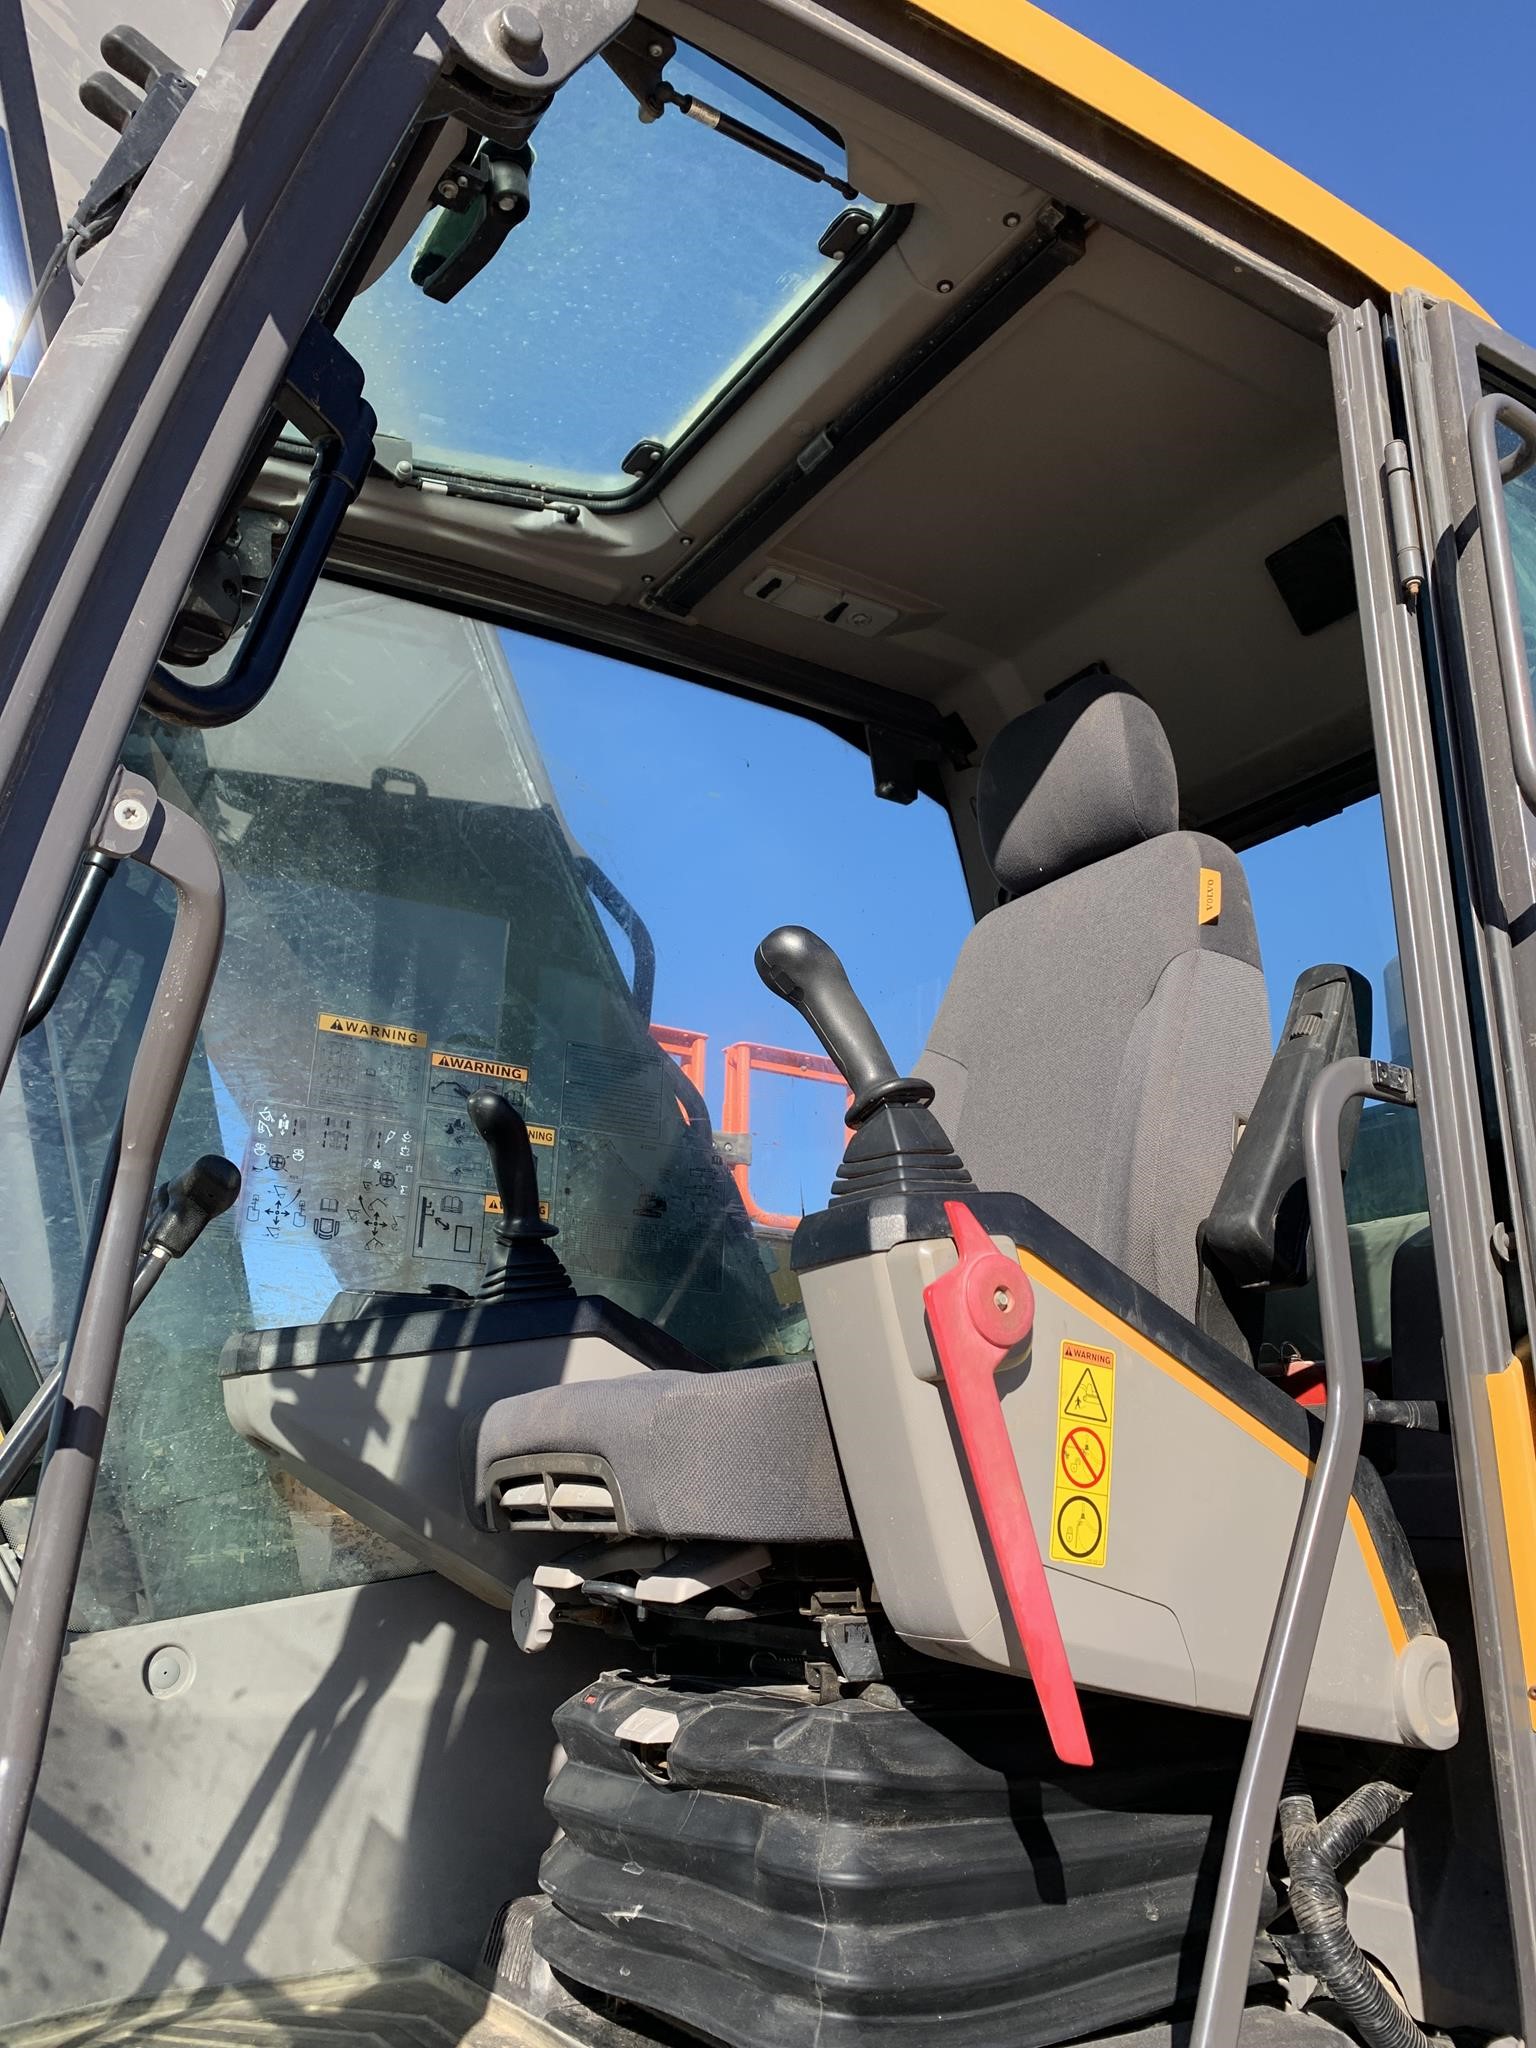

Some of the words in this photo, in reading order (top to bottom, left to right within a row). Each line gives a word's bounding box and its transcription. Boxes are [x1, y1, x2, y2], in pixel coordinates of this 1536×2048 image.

[1206, 879, 1214, 911] VOLVO
[346, 1020, 418, 1043] WARNING
[450, 1057, 522, 1079] WARNING
[528, 1130, 553, 1142] NING
[1073, 1349, 1111, 1365] WARNING
